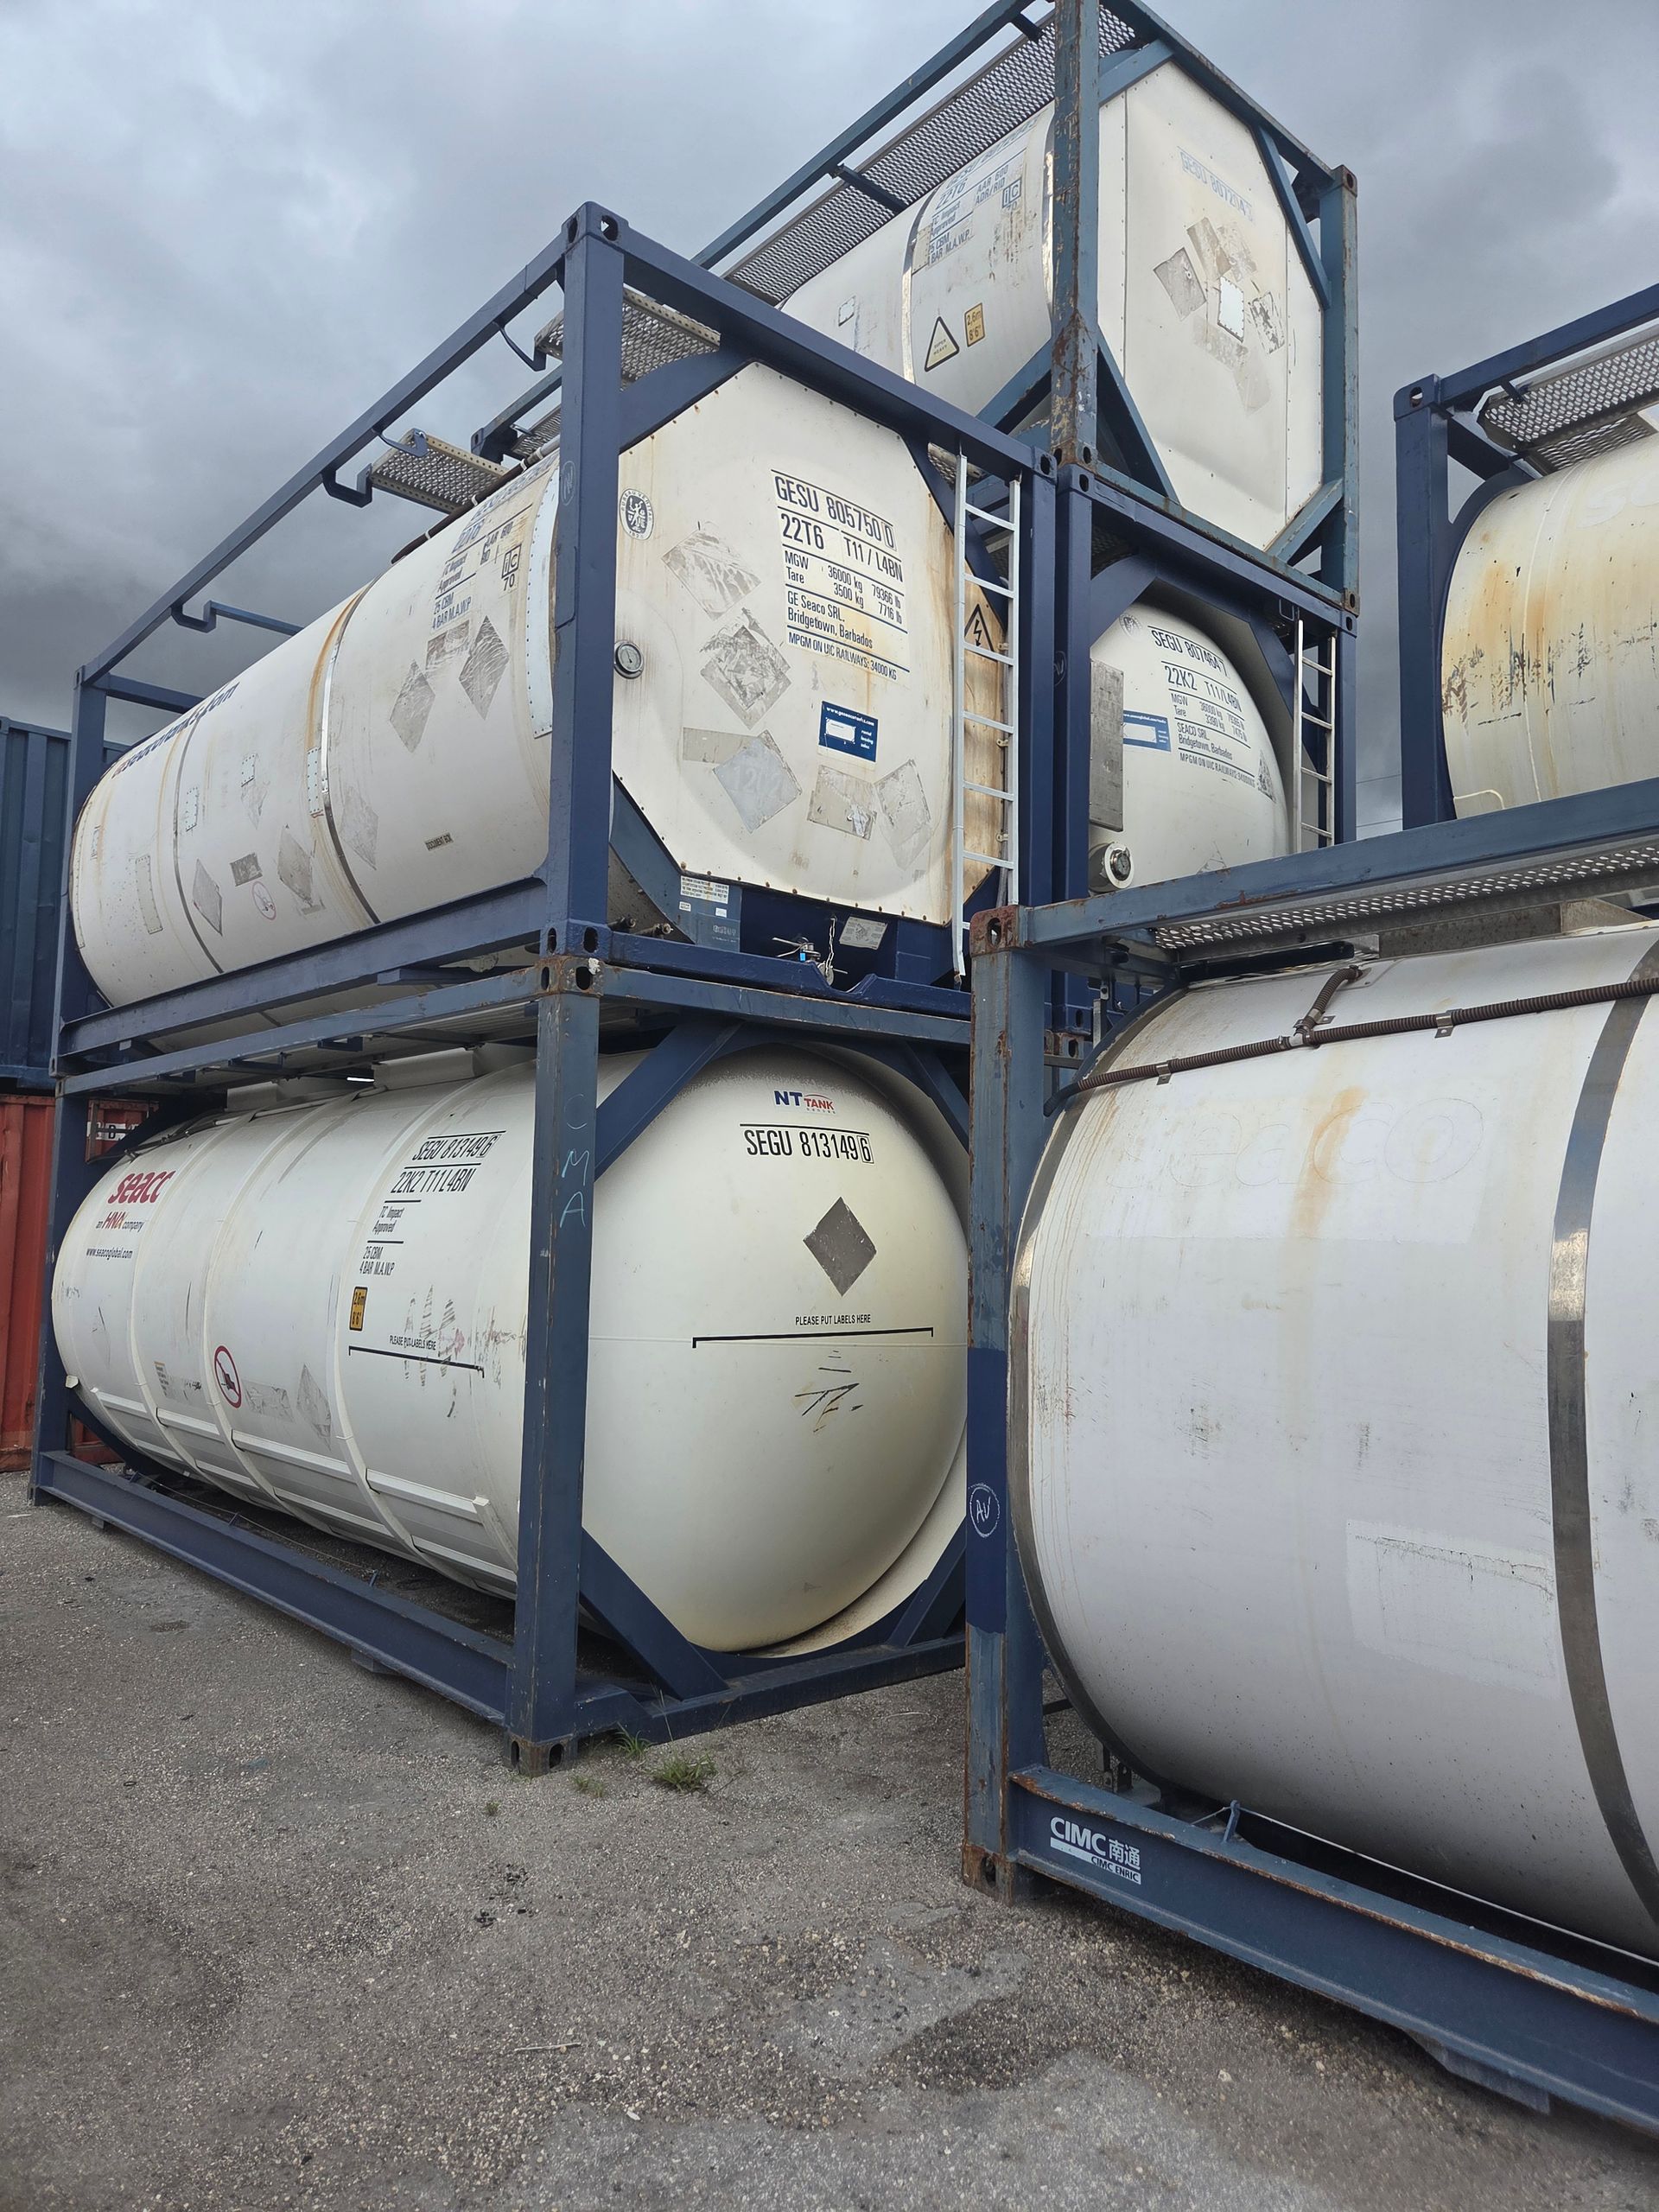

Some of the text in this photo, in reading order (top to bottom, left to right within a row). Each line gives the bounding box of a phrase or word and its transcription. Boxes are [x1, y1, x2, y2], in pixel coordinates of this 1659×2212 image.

[775, 476, 819, 512] GESU
[781, 513, 824, 550] 22T6
[843, 537, 864, 563] T11
[504, 574, 515, 591] 70
[785, 550, 809, 569] MGW
[828, 566, 852, 586] 36000
[854, 576, 863, 593] kg
[786, 567, 804, 583] Tare
[834, 582, 853, 601] 3500
[855, 592, 863, 608] kg
[787, 591, 845, 622] GE Seaco SRL.
[436, 610, 448, 628] BAR
[787, 607, 873, 648] Bridgetown, Barbados
[1152, 630, 1183, 653] SEGU
[788, 632, 896, 680] MPGM ON UIC RAILWAYS: 34000 KG
[1165, 665, 1197, 690] 22K2
[1171, 693, 1188, 706] MGW
[1173, 705, 1186, 716] Tare
[774, 1090, 835, 1110] NT TANK
[412, 1140, 448, 1160] SEGU
[744, 1129, 792, 1156] SEGU
[391, 1170, 425, 1193] 22K2
[102, 1211, 128, 1230] HNA
[372, 1220, 397, 1235] Approved
[363, 1246, 384, 1260] 25 CBM
[362, 1262, 373, 1274] BAR
[796, 1313, 871, 1325] PLEASE PUT LABELS HERE
[390, 1335, 404, 1345] PLEASE
[426, 1340, 435, 1351] HERE
[1051, 1817, 1106, 1857] CIMC
[1109, 1839, 1141, 1871] 南通
[1091, 1856, 1139, 1883] CIMC ENRIC
